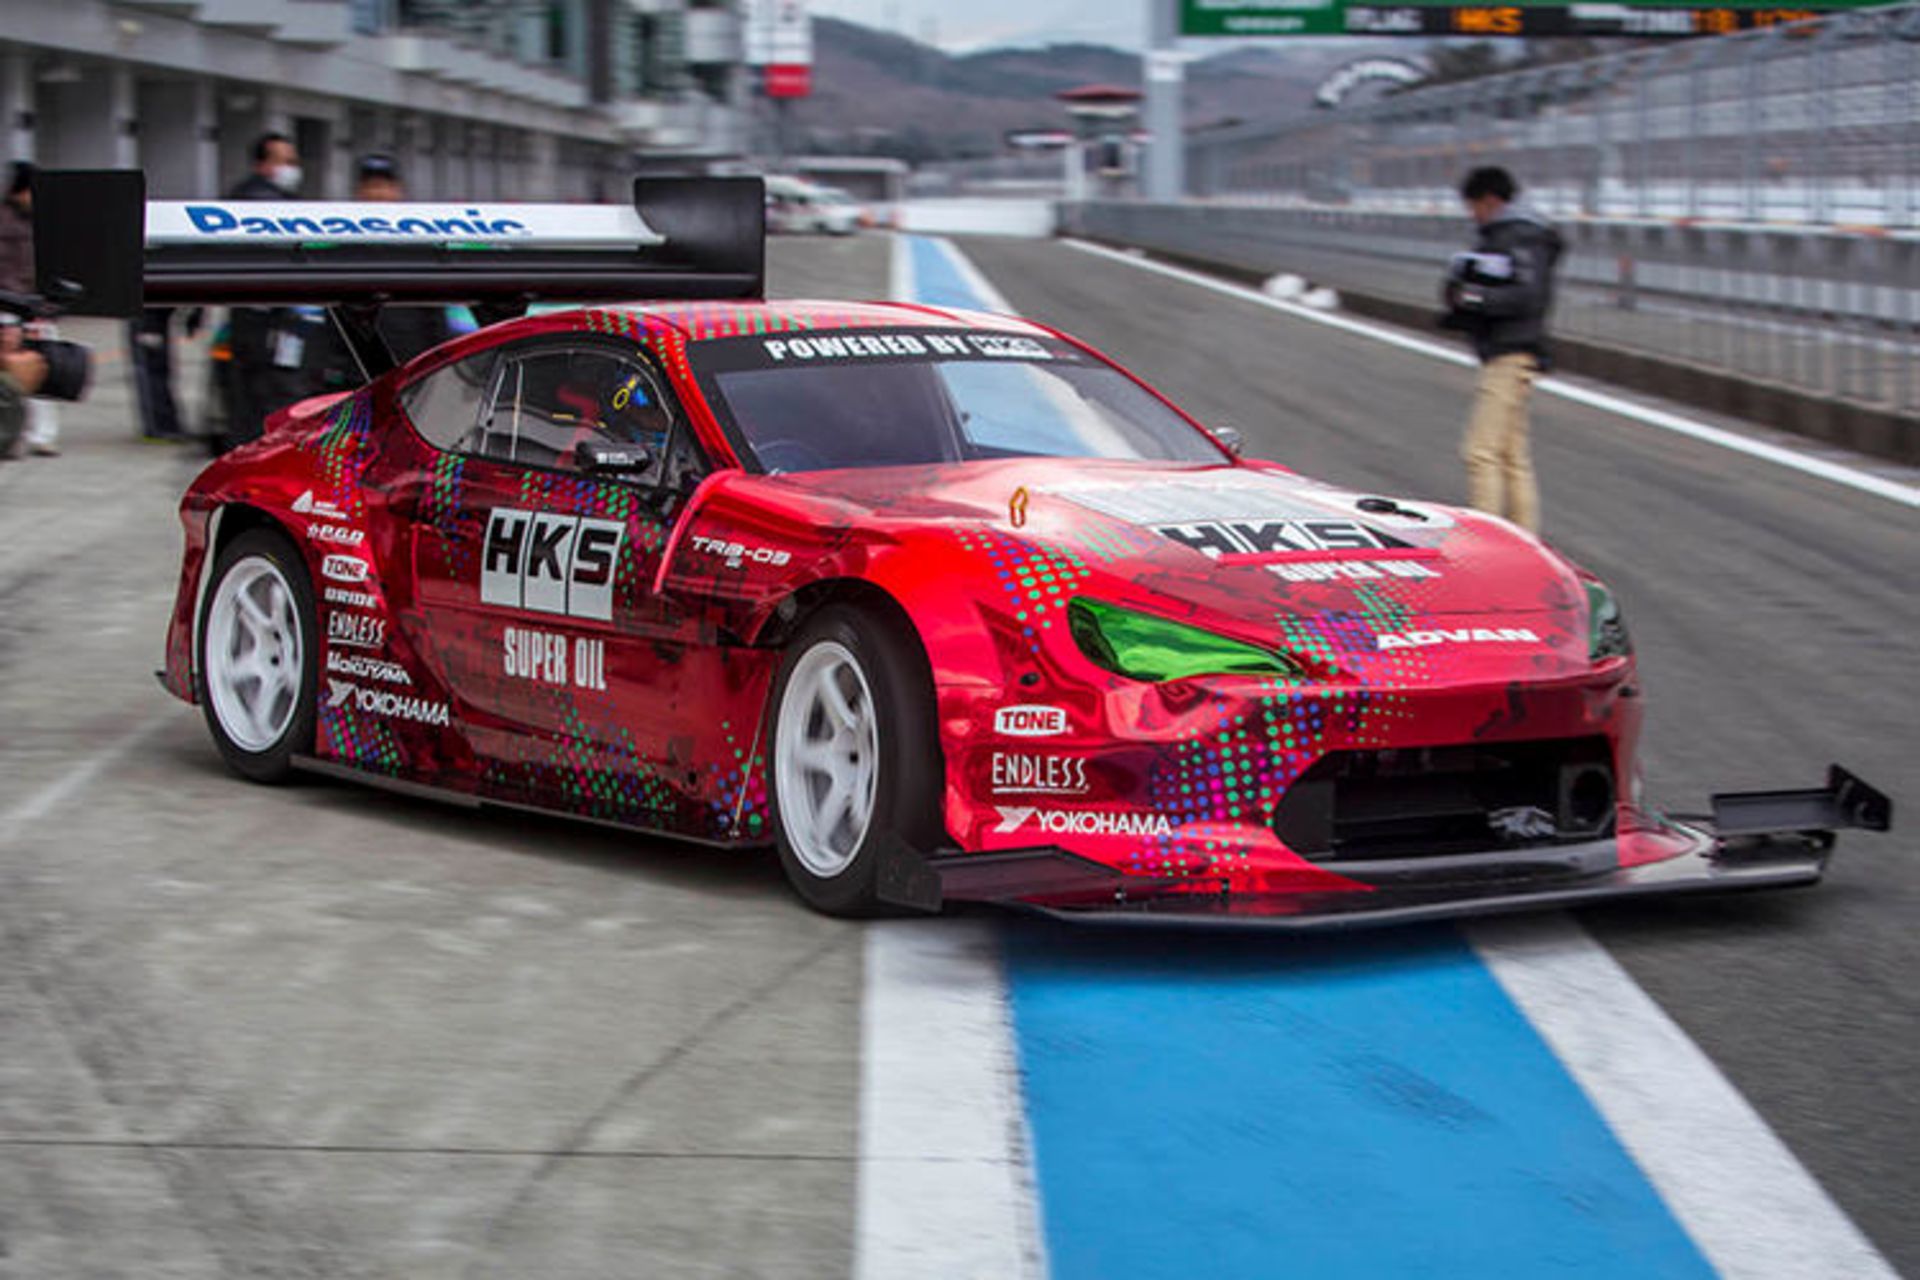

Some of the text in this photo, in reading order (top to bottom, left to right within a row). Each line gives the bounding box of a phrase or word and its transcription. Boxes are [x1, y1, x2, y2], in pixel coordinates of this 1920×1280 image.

[185, 205, 525, 234] Panasonic
[764, 335, 927, 360] POWERED
[924, 335, 971, 354] BY
[485, 514, 620, 588] HKS
[1157, 521, 1374, 556] HKS
[326, 557, 365, 579] TONE
[328, 611, 386, 642] ENDLESS
[1377, 629, 1541, 649] ADVAN
[504, 627, 608, 691] SUPER OIL
[354, 687, 449, 726] YOKOHAMA
[999, 711, 1061, 731] TONE
[992, 752, 1087, 788] ENDLESS
[1036, 810, 1173, 835] YOKOHAMA
